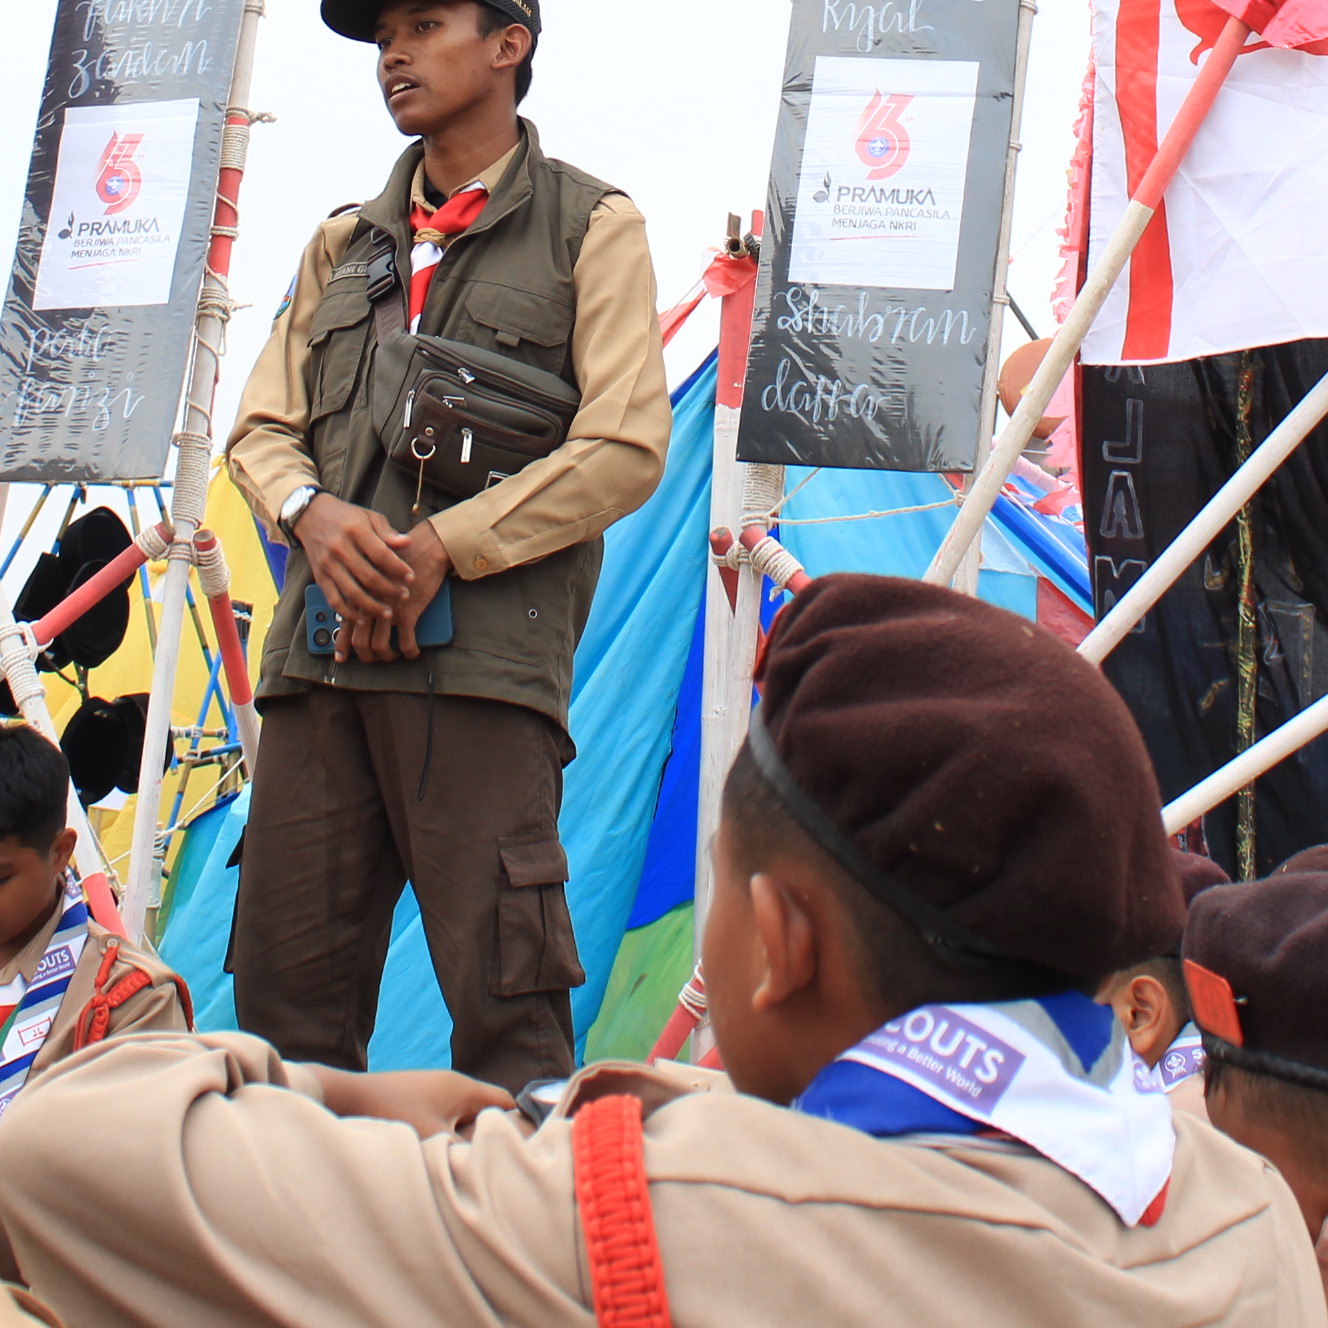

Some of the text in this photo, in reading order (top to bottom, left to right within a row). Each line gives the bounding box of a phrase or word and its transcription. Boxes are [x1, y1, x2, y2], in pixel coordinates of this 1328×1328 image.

[837, 185, 936, 206] PRAMUKA
[834, 204, 951, 220] BERJIWA PANCASILA
[77, 217, 160, 237] PRAMUKA
[832, 218, 917, 231] MENJAGA NKRI
[74, 234, 170, 248] BERJIWA PANCASILA
[71, 247, 142, 259] MENJAGA NKRI
[37, 949, 70, 972] OUTS
[907, 1046, 944, 1074] Better
[945, 1065, 983, 1099] World
